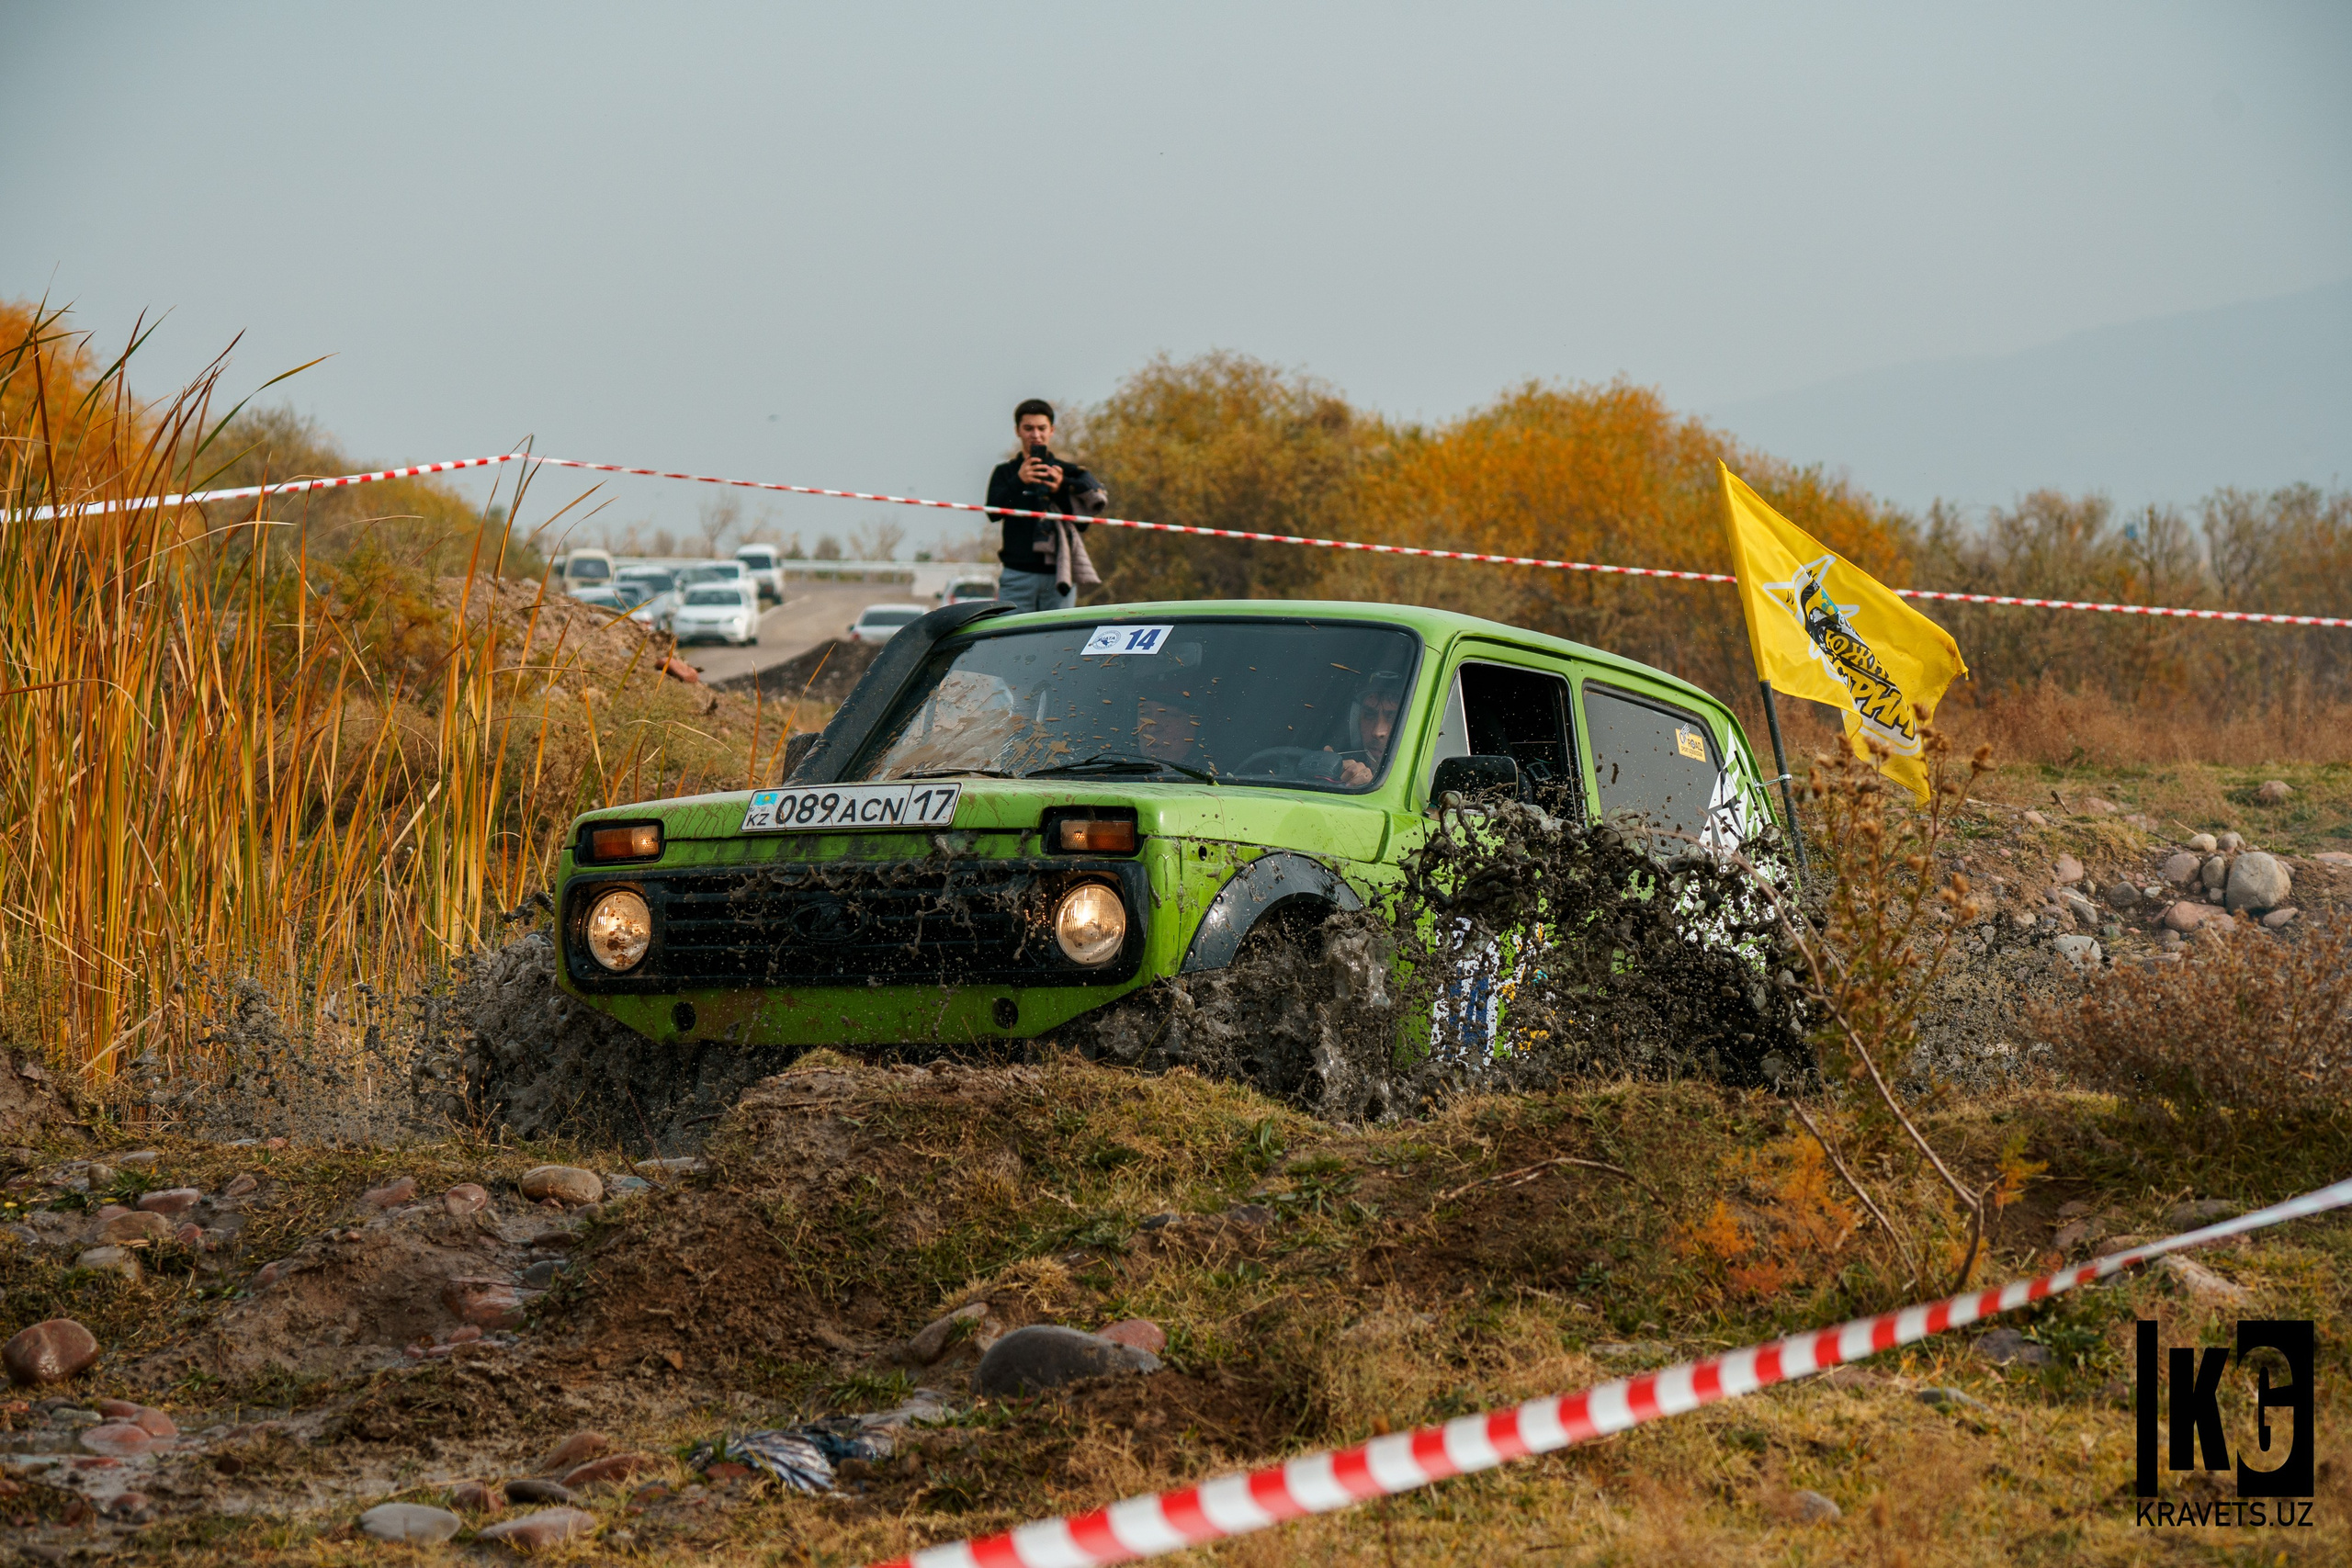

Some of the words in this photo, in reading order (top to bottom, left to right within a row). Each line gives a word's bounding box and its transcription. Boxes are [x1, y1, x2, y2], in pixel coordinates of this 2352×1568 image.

[1125, 629, 1162, 650] 14
[775, 793, 905, 824] 089ACN
[913, 789, 956, 821] 17
[746, 813, 770, 827] KZ
